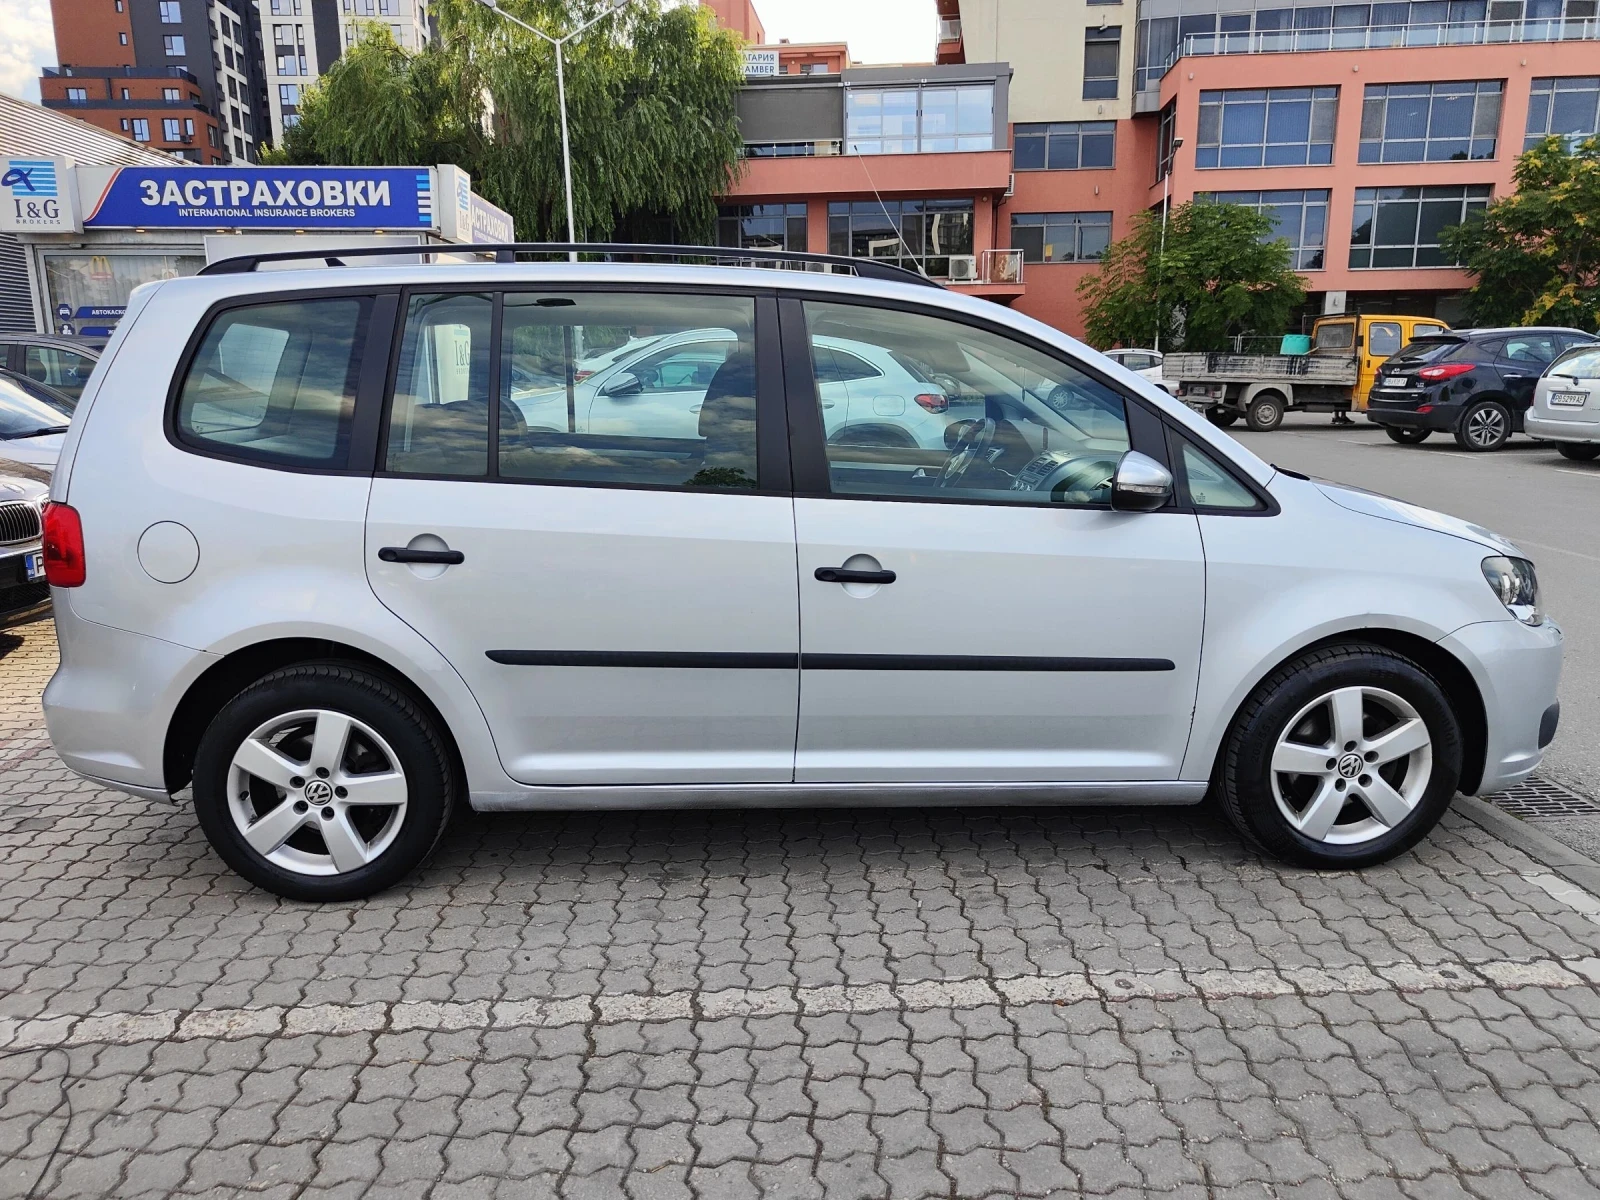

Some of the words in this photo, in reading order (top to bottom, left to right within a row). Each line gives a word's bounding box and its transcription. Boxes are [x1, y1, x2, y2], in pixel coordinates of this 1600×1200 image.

[139, 179, 391, 207] ЗАСТРАХОВКИ
[178, 208, 253, 217] INTERNATIONAL
[254, 208, 308, 217] INSURANCE
[310, 208, 356, 217] BROKERS
